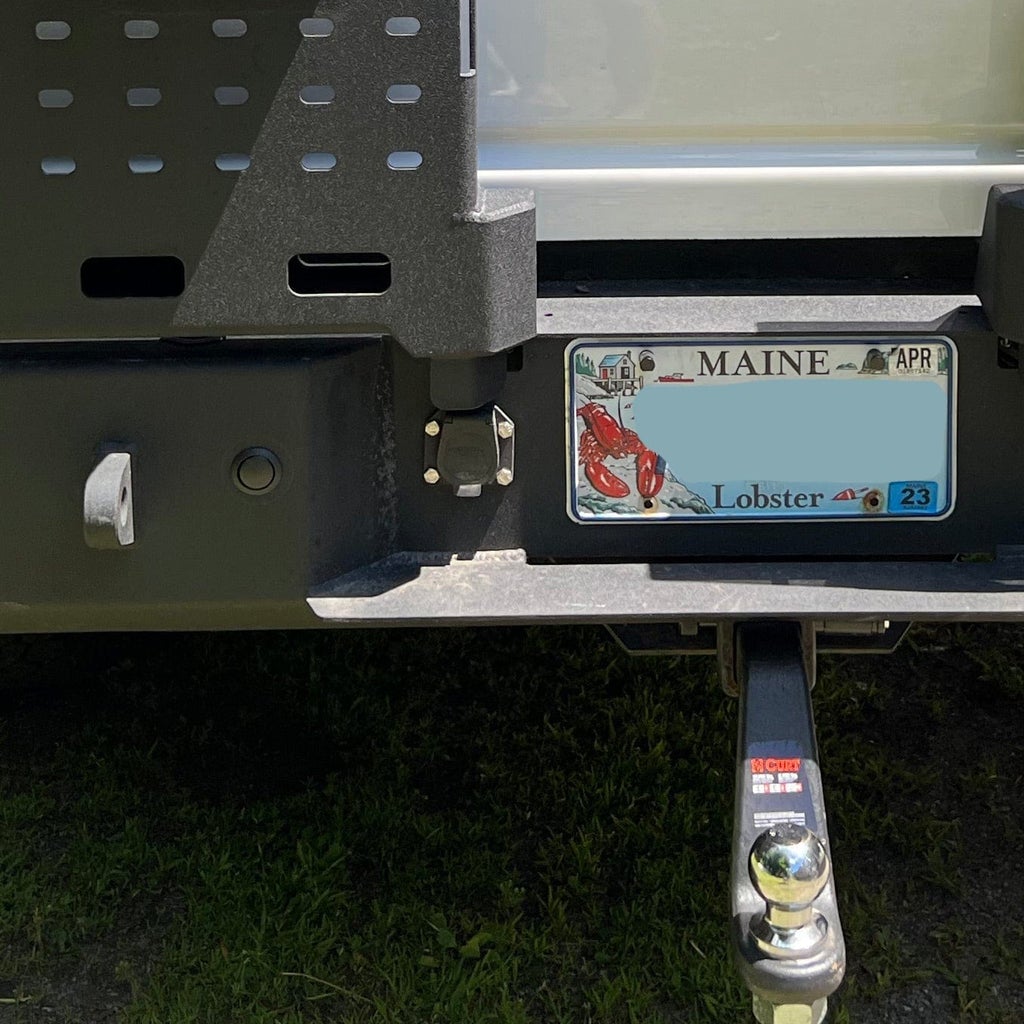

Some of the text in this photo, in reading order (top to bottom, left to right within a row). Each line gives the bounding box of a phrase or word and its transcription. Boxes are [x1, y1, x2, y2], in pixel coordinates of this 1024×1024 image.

[697, 350, 830, 376] MAINE
[896, 347, 931, 369] APR
[712, 484, 825, 509] Lobster
[901, 488, 931, 505] 23
